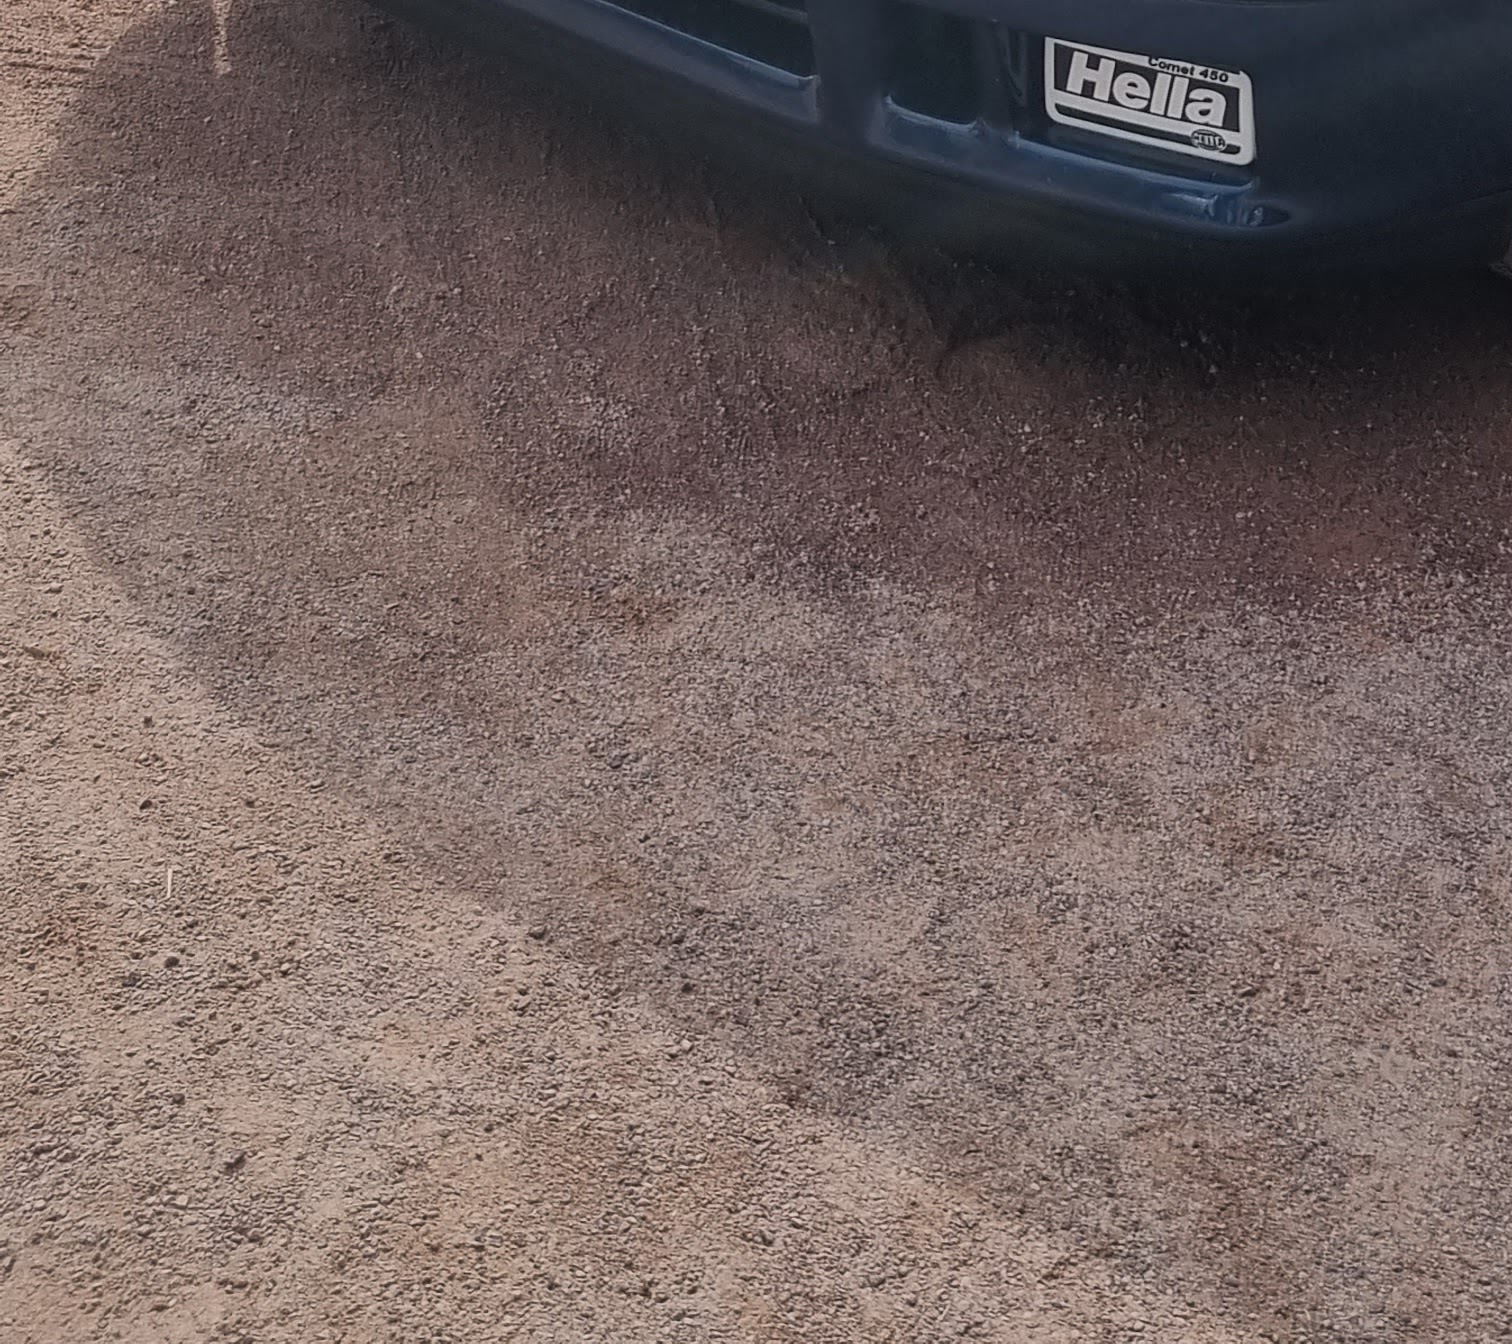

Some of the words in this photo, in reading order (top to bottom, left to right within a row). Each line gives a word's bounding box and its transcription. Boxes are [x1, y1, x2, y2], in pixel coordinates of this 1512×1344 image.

[1065, 50, 1227, 128] Hella
[1148, 56, 1195, 76] Comet
[1199, 69, 1229, 83] 450
